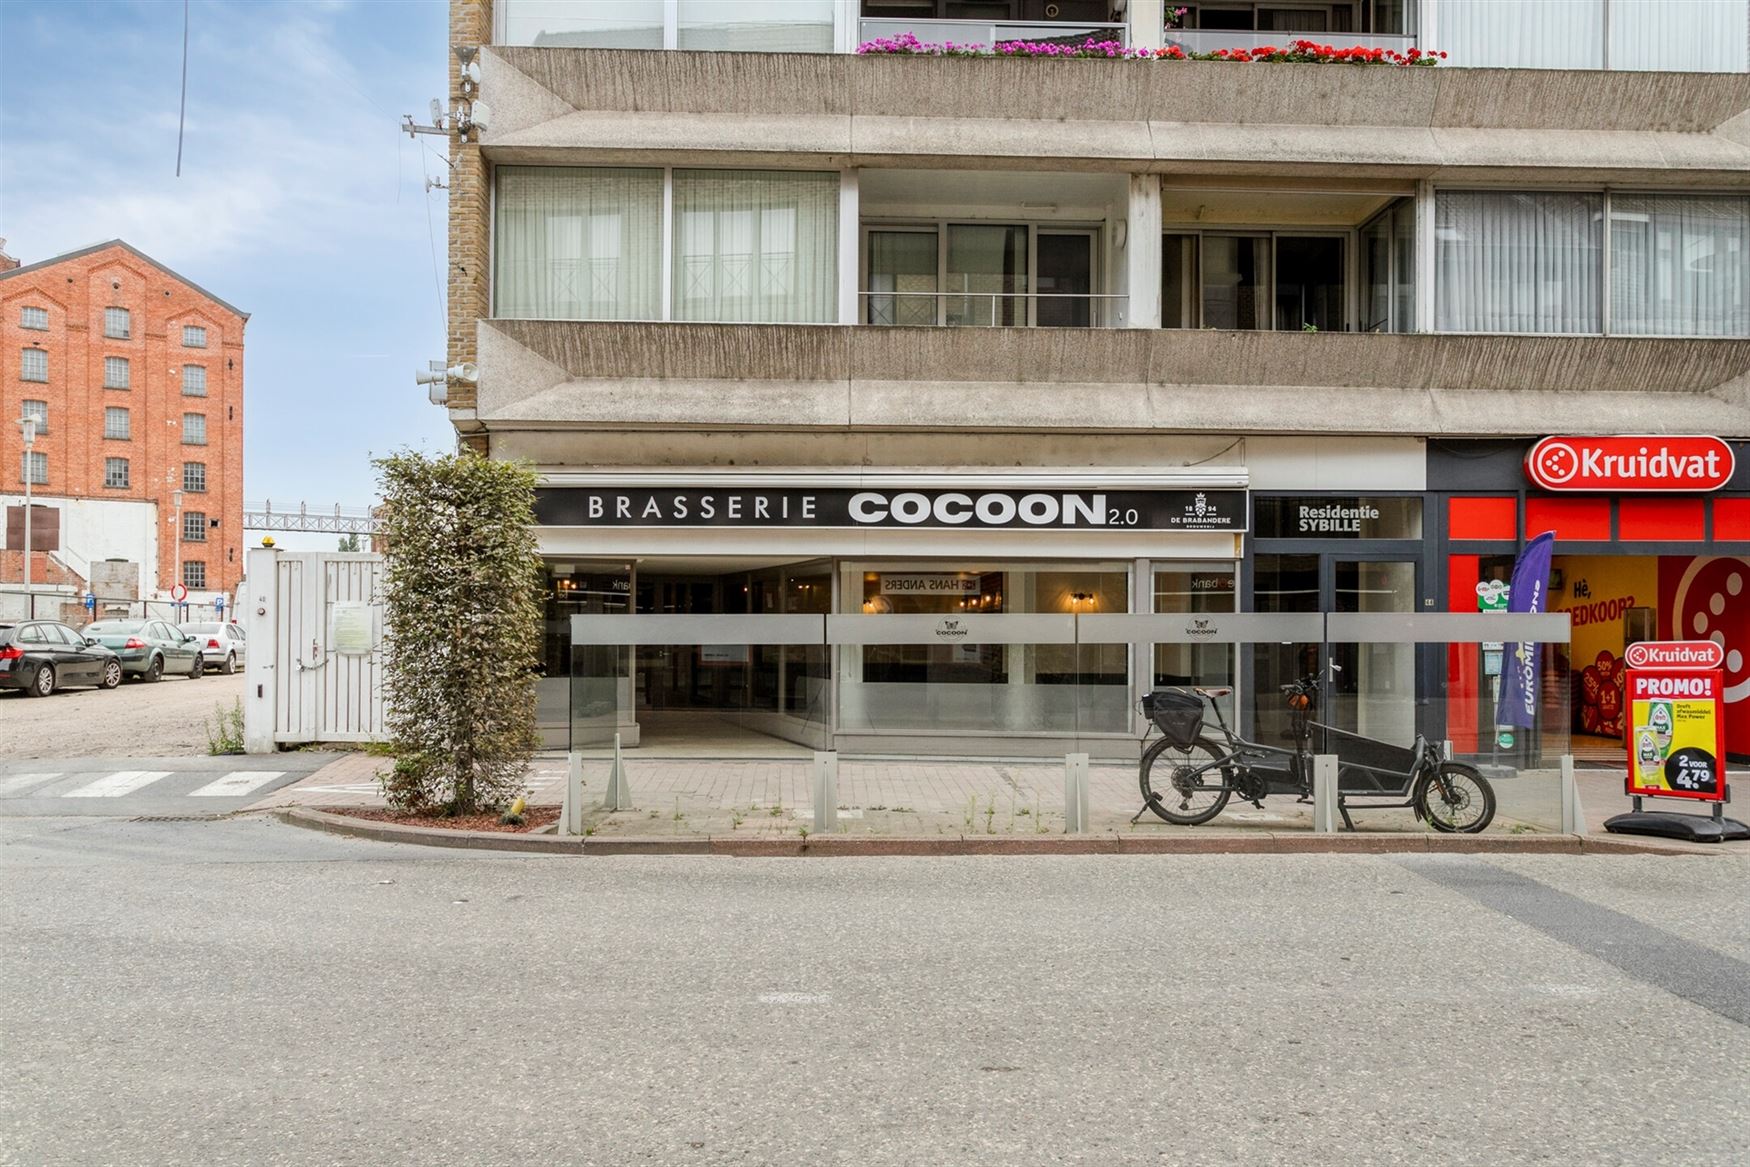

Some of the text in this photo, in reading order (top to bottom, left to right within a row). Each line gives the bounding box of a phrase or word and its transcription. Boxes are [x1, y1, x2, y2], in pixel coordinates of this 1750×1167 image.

[1582, 447, 1720, 478] Kruidvat
[588, 492, 1138, 525] BRASSERIE COCOON 2.0
[1299, 505, 1379, 519] Residentie
[1299, 519, 1361, 532] SYBILLE
[1573, 578, 1591, 599] Hè,
[1557, 595, 1635, 627] EDKOOP?
[1649, 647, 1715, 662] Kruidvat
[1597, 660, 1612, 671] 50%
[1636, 678, 1712, 696] PROMO!
[1600, 690, 1616, 704] 1+1
[1679, 755, 1689, 767] 2
